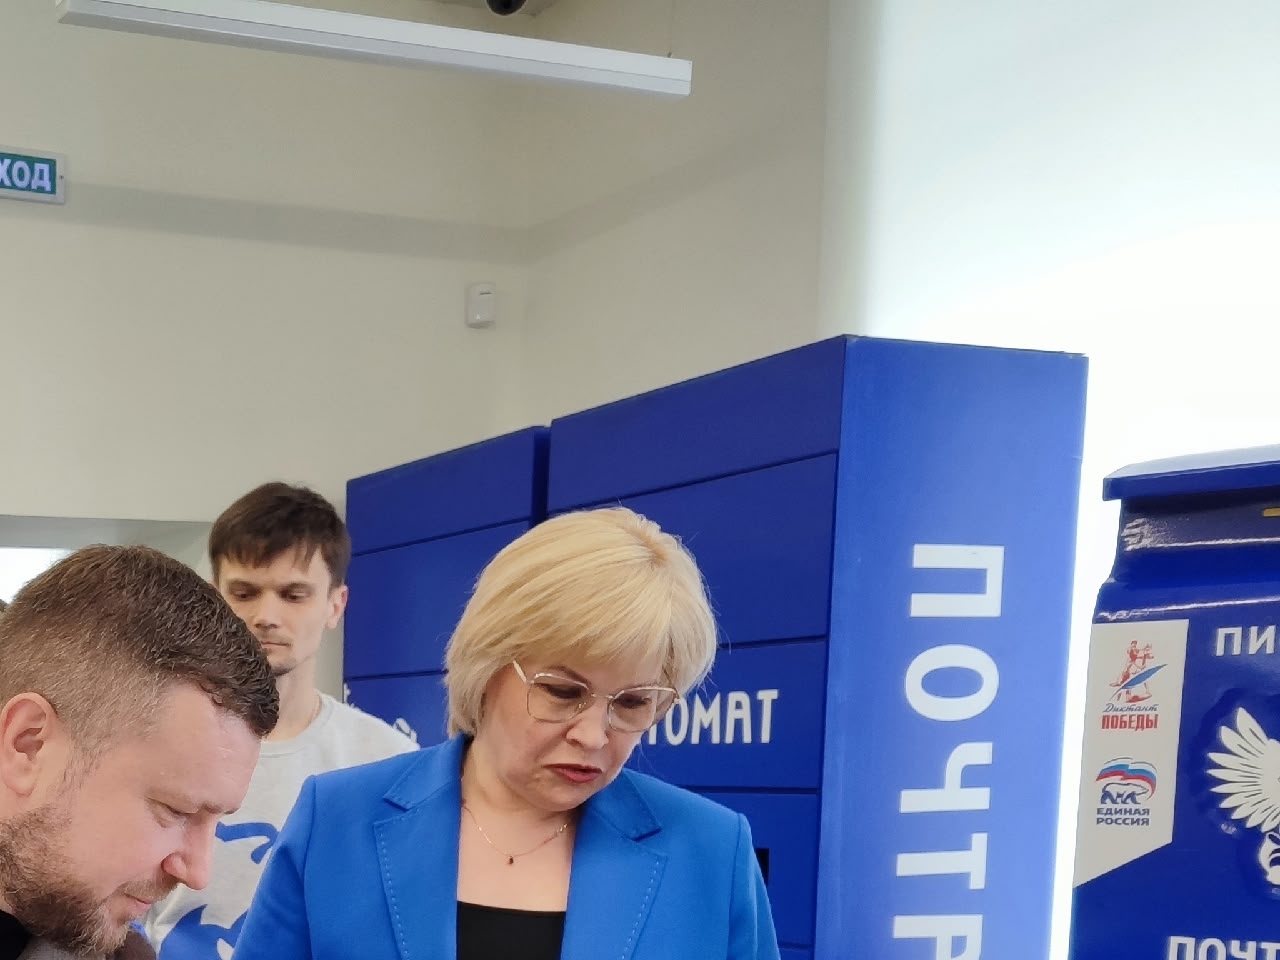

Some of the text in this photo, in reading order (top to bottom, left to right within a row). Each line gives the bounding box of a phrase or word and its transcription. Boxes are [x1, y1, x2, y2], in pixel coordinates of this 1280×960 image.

[1103, 702, 1160, 713] Диктант
[1101, 714, 1159, 731] ПОБЕДЫ
[1096, 807, 1150, 816] ЕДИНАЯ
[1096, 817, 1150, 826] РОССИЯ
